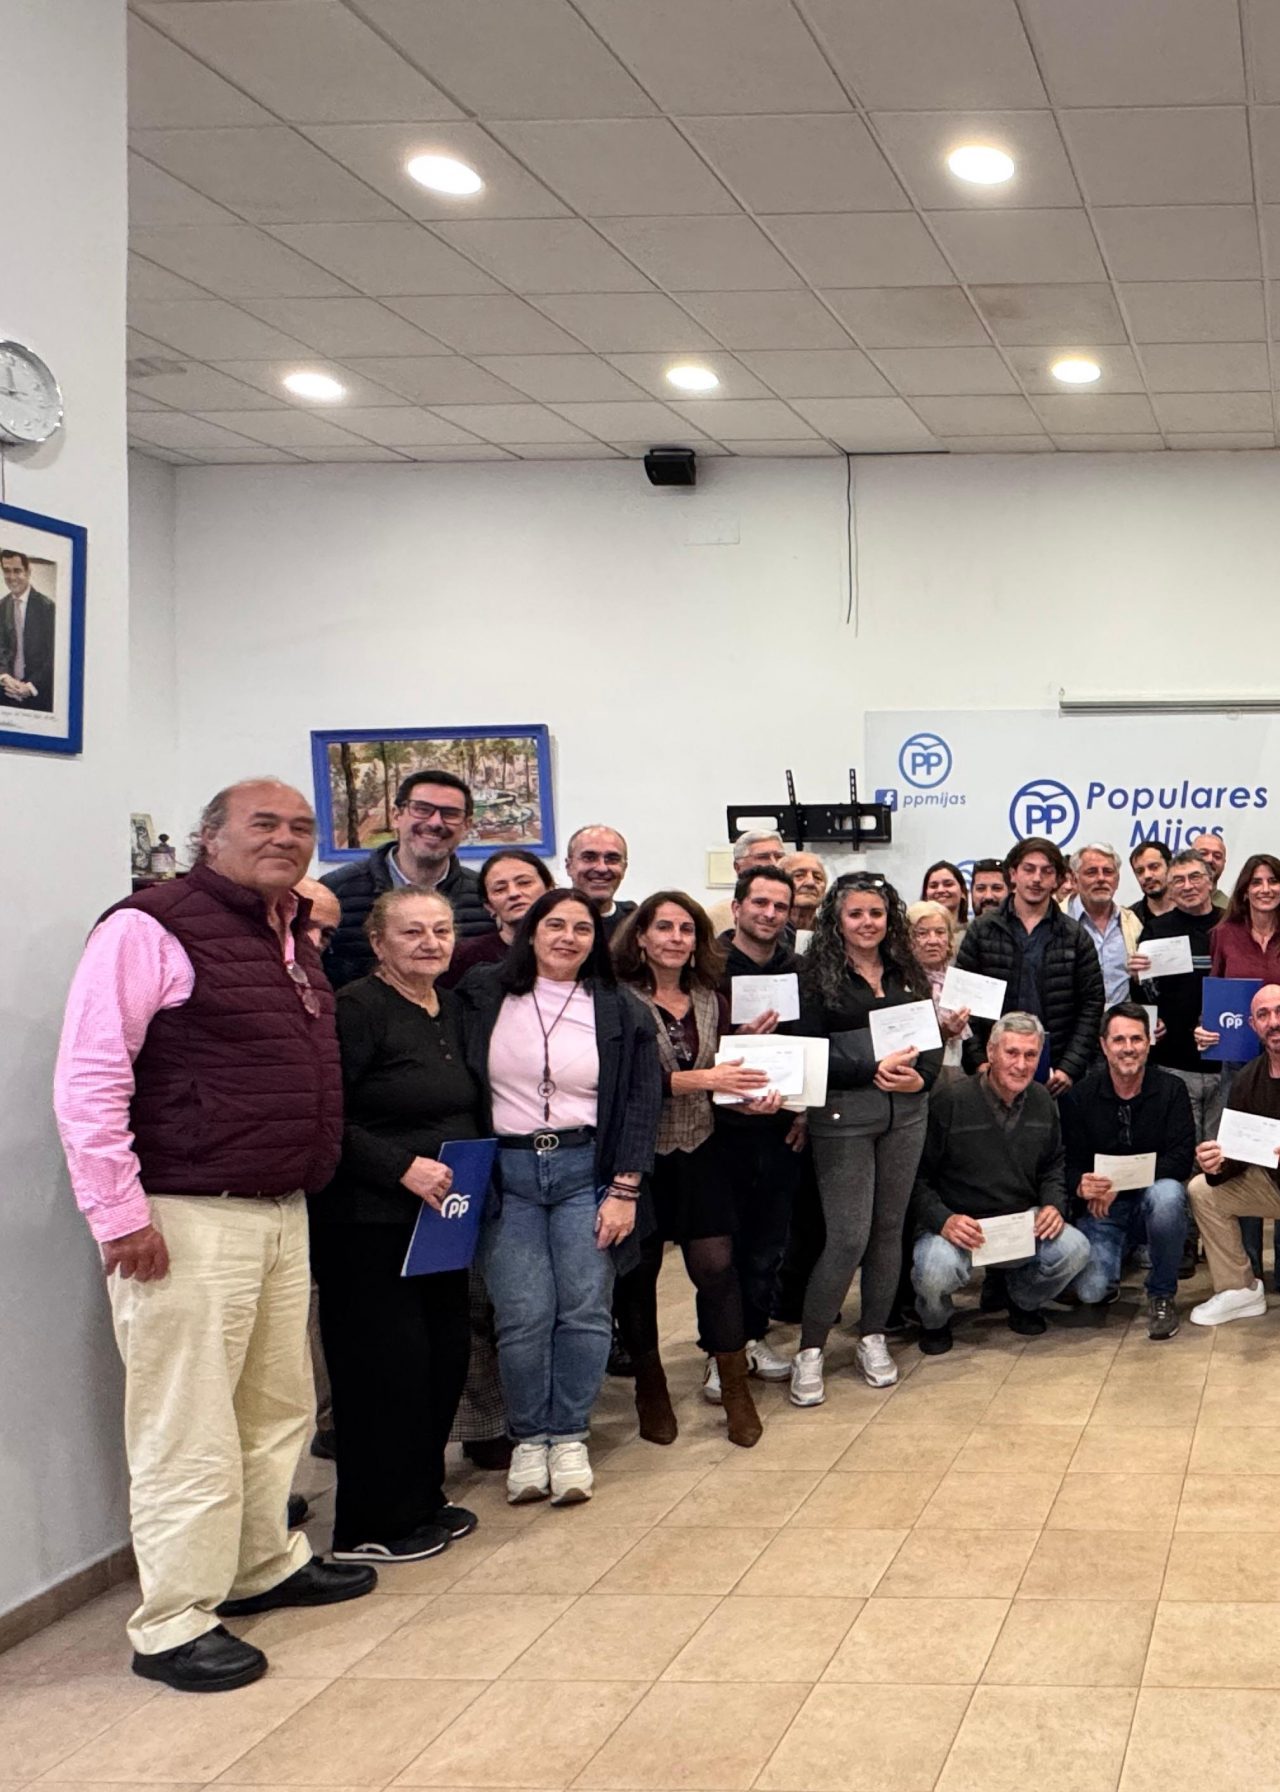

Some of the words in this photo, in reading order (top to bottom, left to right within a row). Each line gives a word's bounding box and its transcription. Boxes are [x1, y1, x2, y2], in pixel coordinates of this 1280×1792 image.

[911, 752, 943, 776] PP
[903, 792, 966, 808] ppmijas
[1086, 780, 1268, 816] Populares
[1026, 804, 1067, 835] PP
